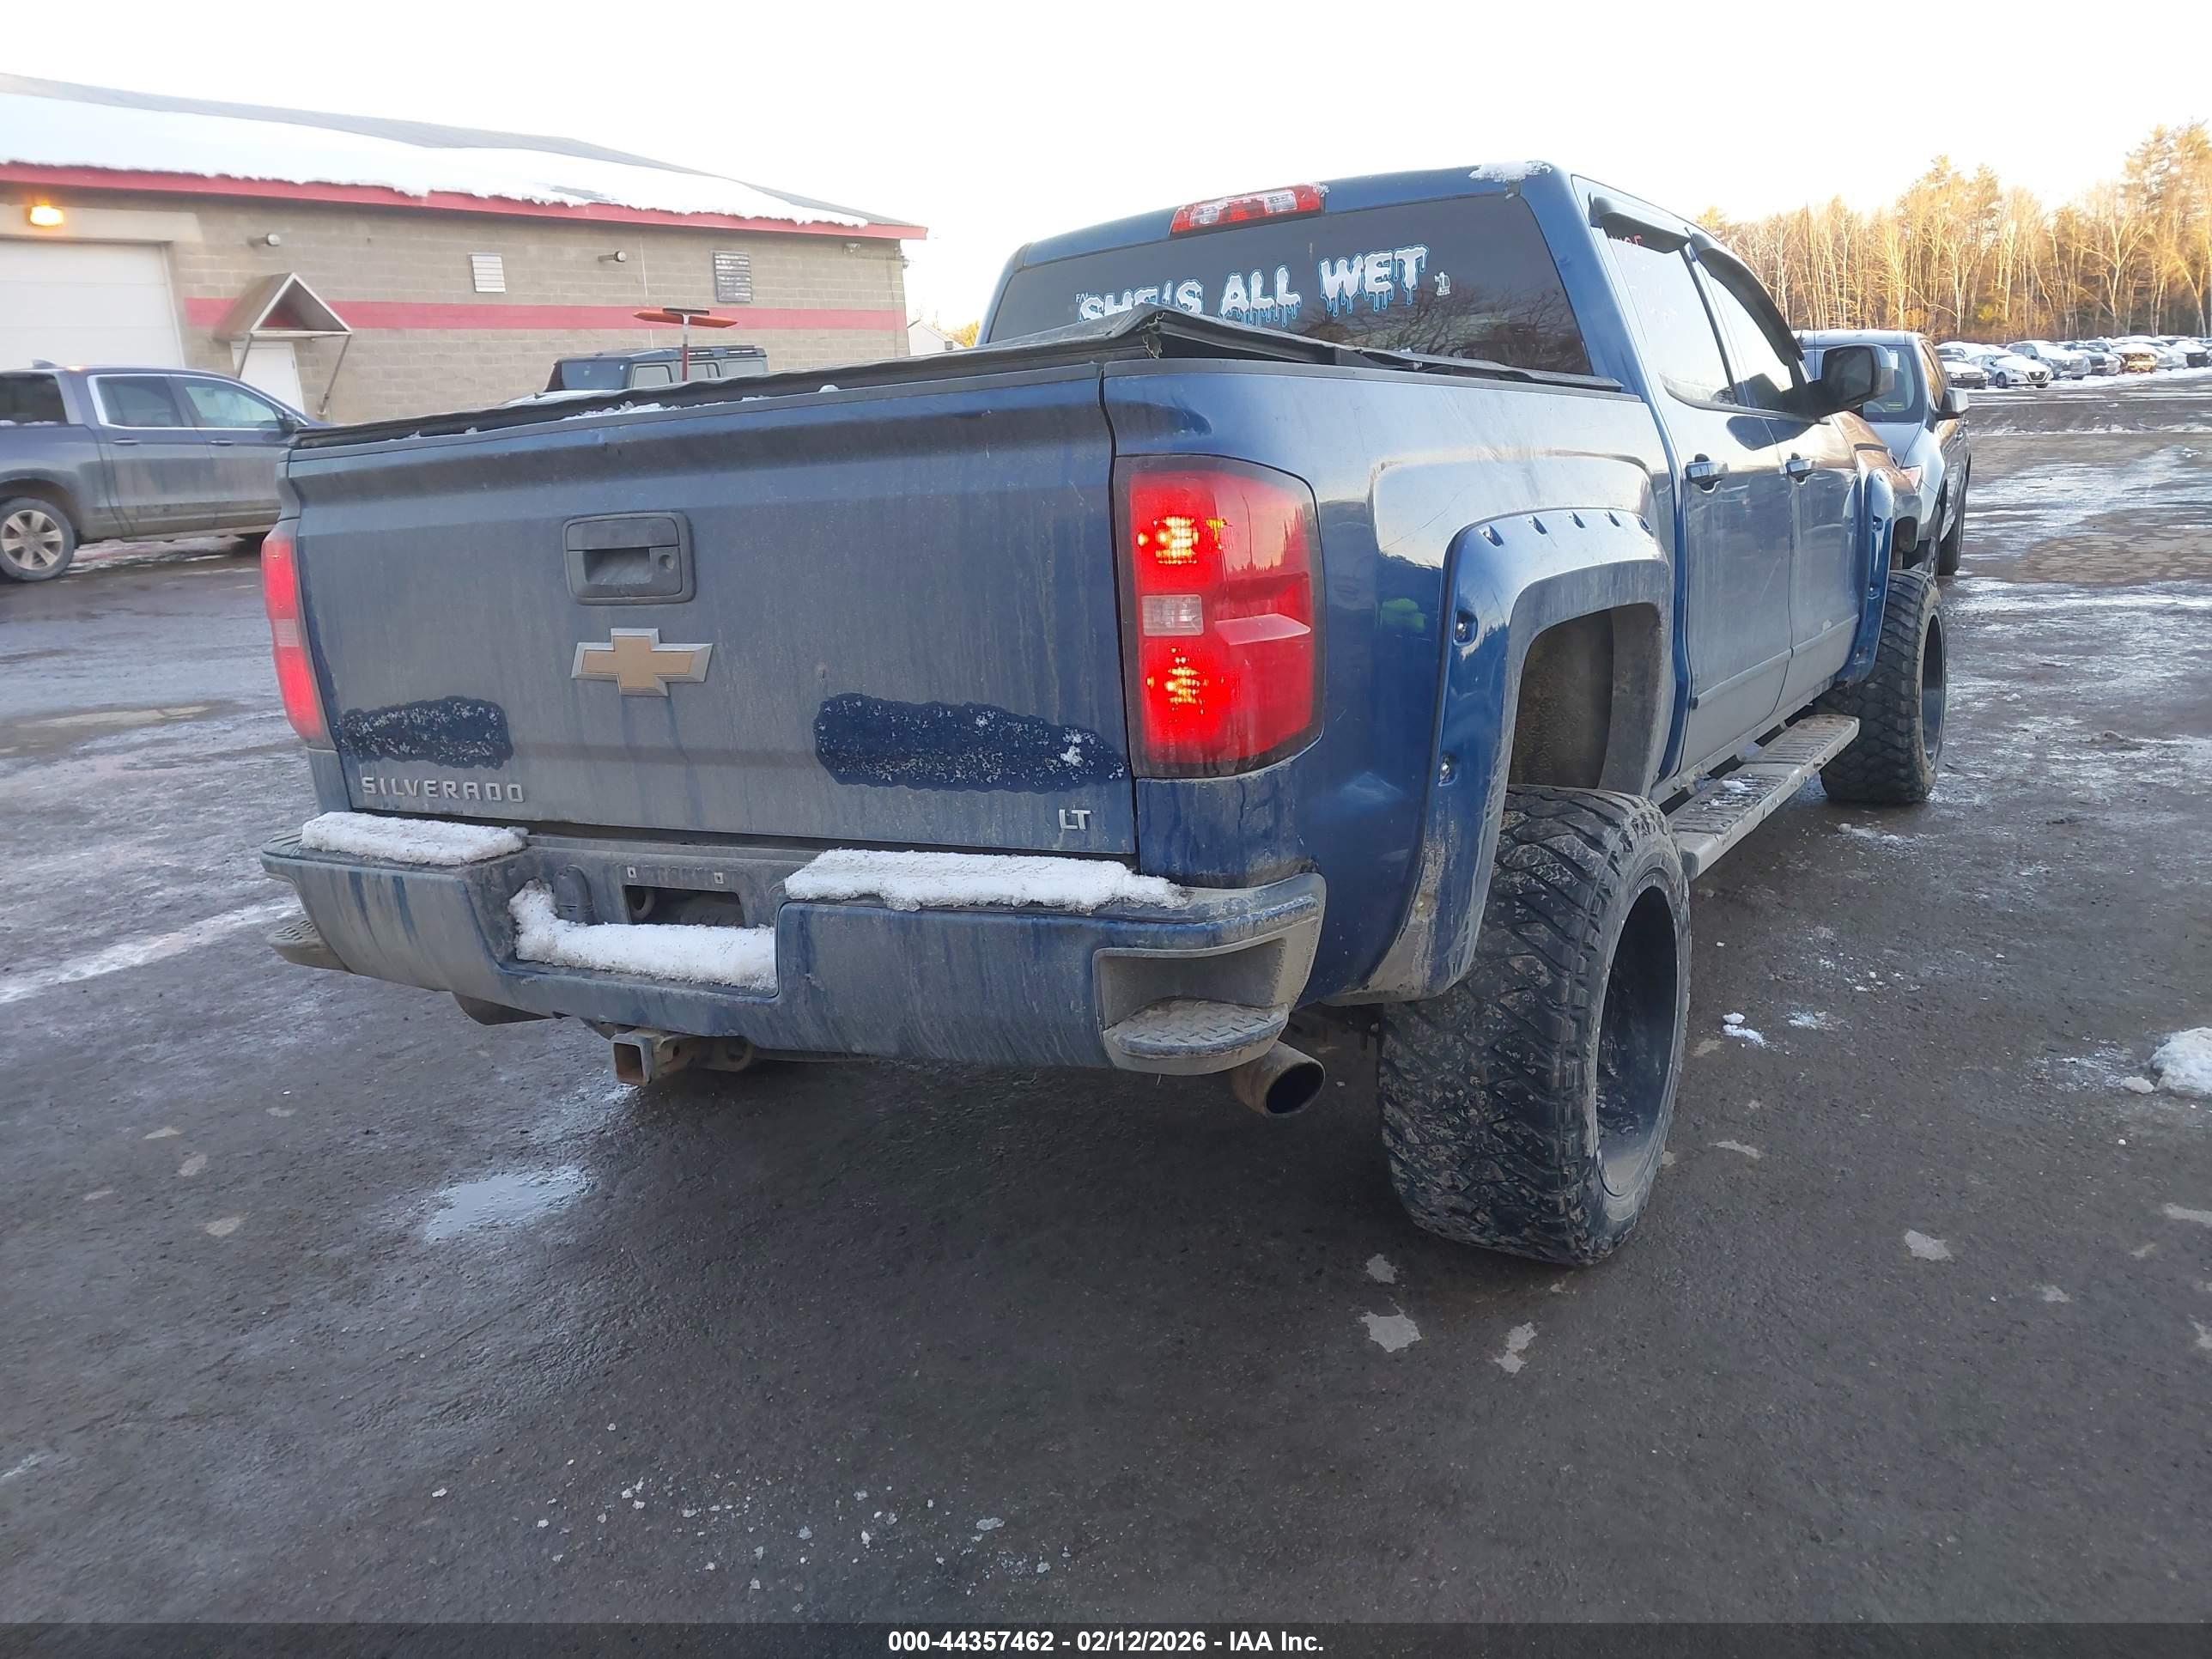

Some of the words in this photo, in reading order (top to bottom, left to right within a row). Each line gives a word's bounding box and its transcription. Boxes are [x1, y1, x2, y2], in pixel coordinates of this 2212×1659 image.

[1218, 265, 1302, 328] ALL
[1319, 244, 1429, 317] WET
[361, 775, 526, 804] SILVERADO
[1057, 808, 1092, 831] LT
